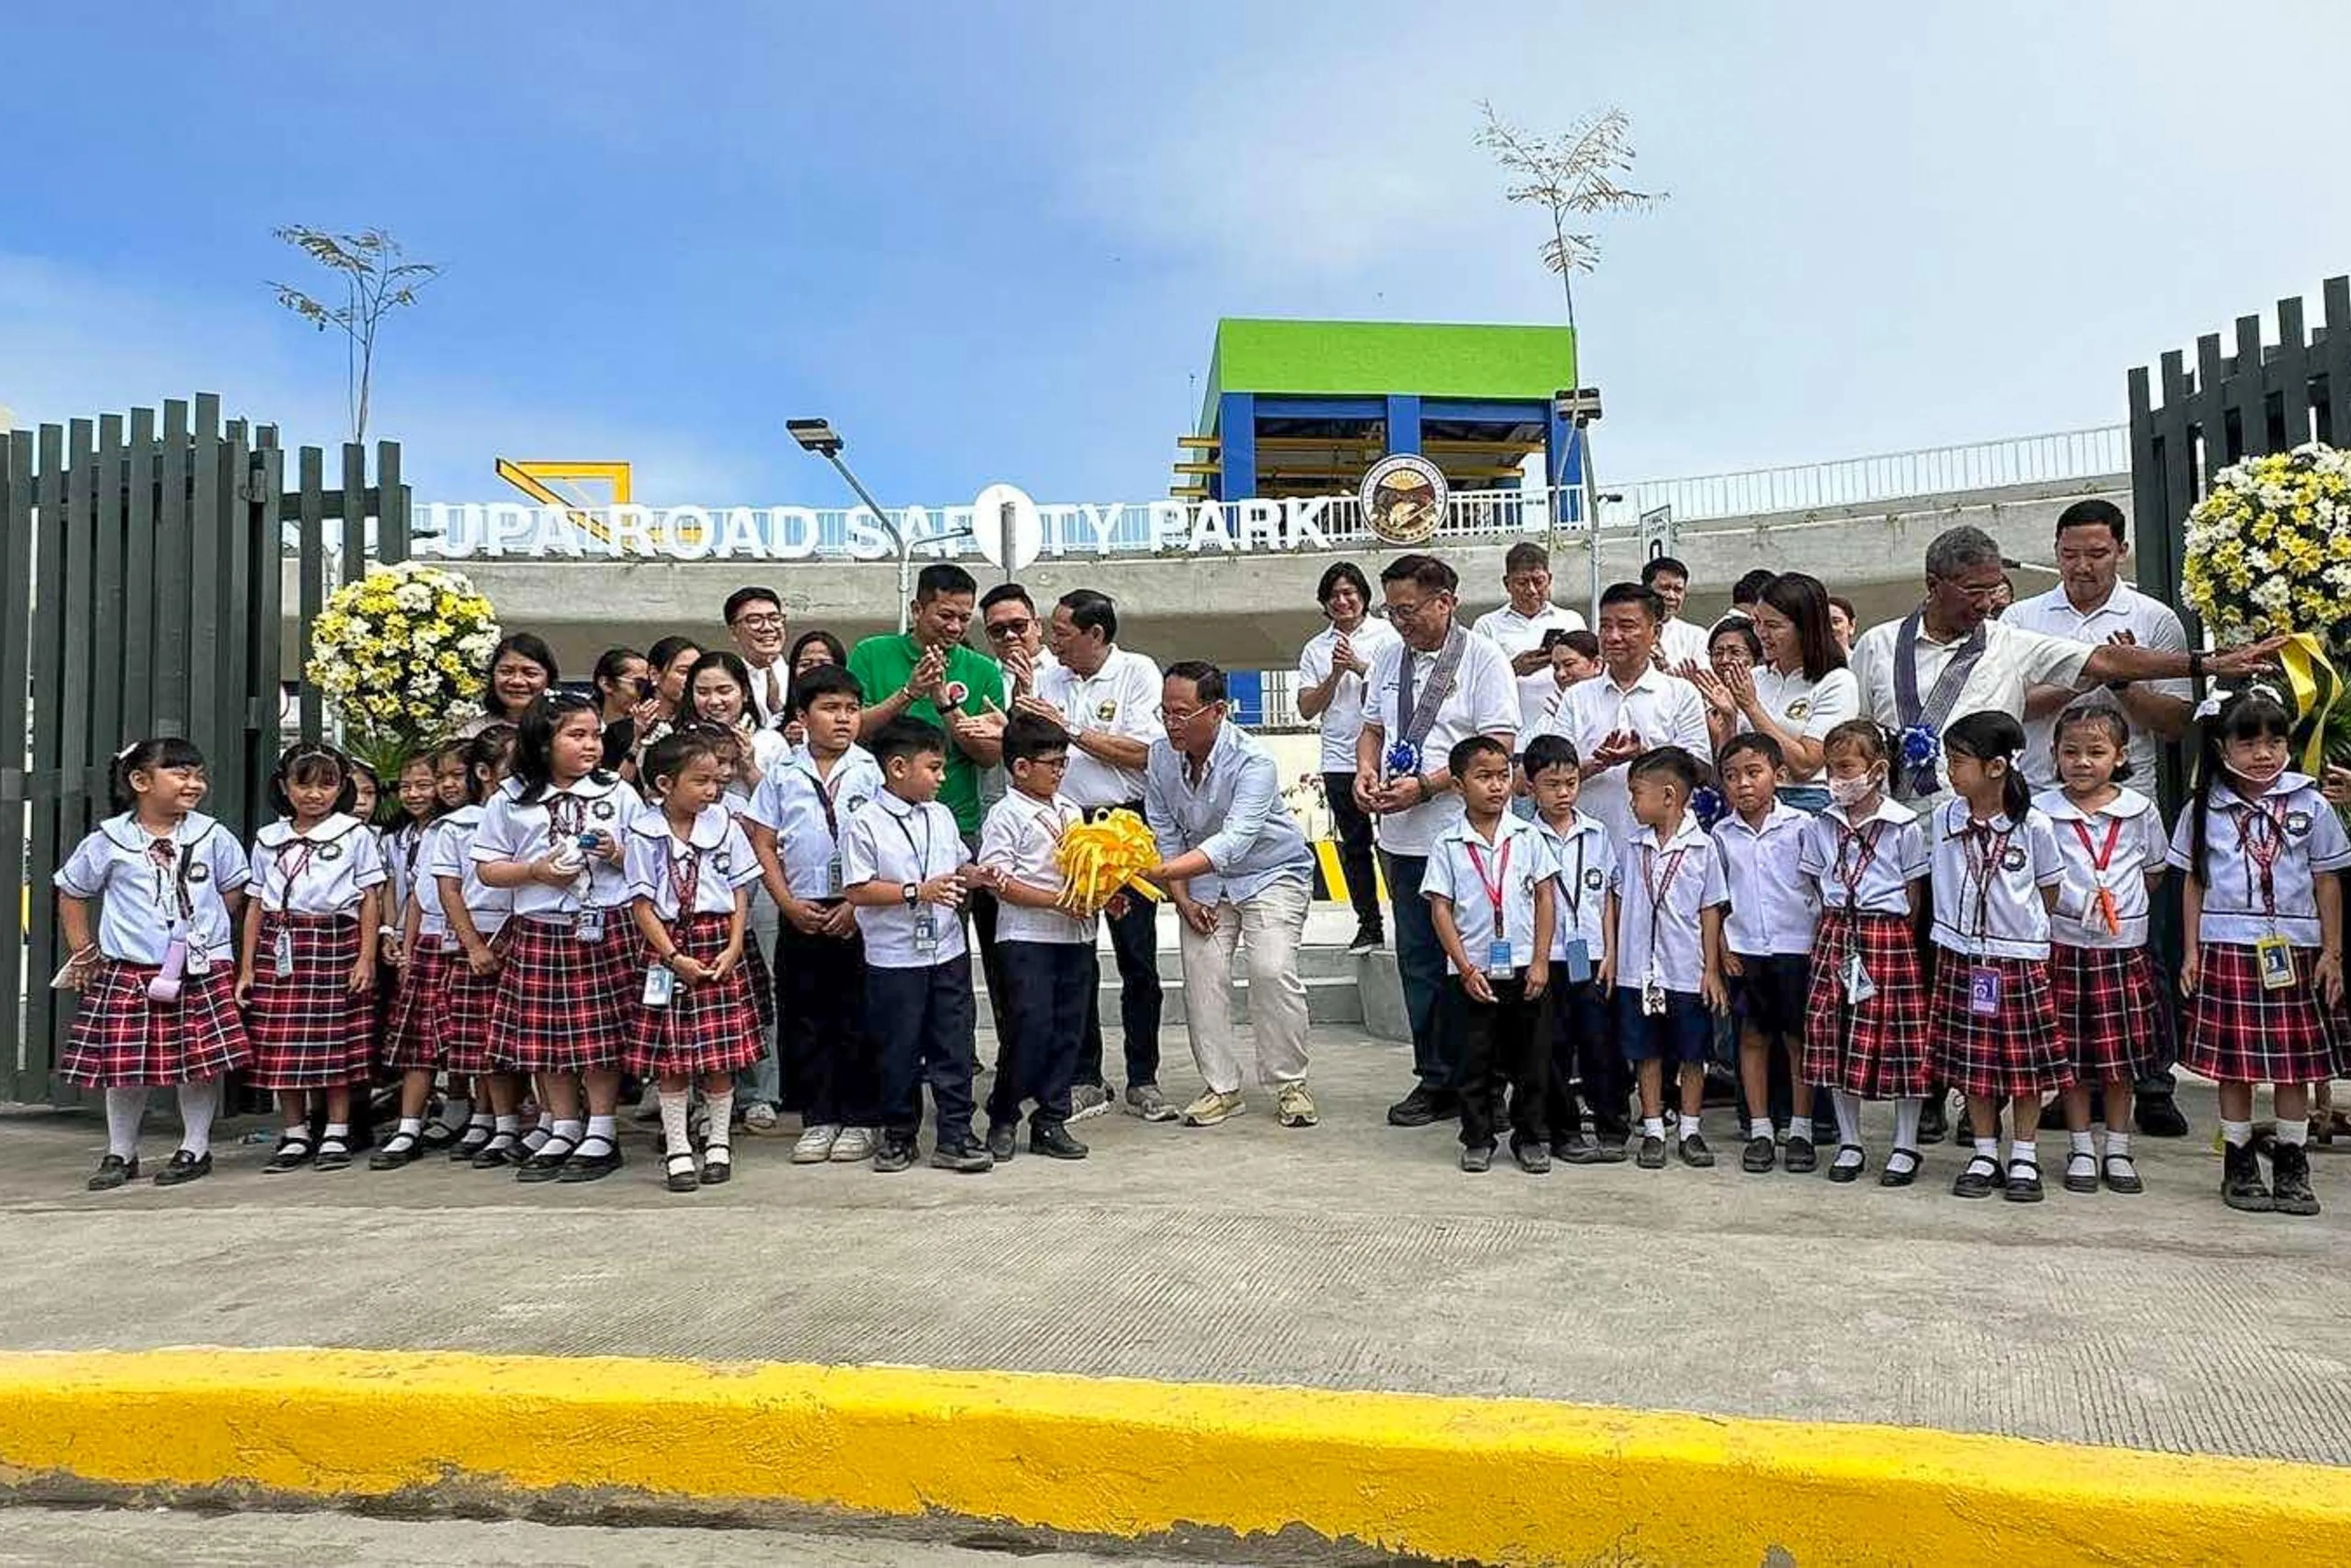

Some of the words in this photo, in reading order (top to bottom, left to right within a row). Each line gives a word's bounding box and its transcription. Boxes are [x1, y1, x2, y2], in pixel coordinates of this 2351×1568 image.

[609, 503, 819, 559] ROAD
[845, 502, 1125, 558] SAFTY
[1148, 497, 1332, 552] PARK
